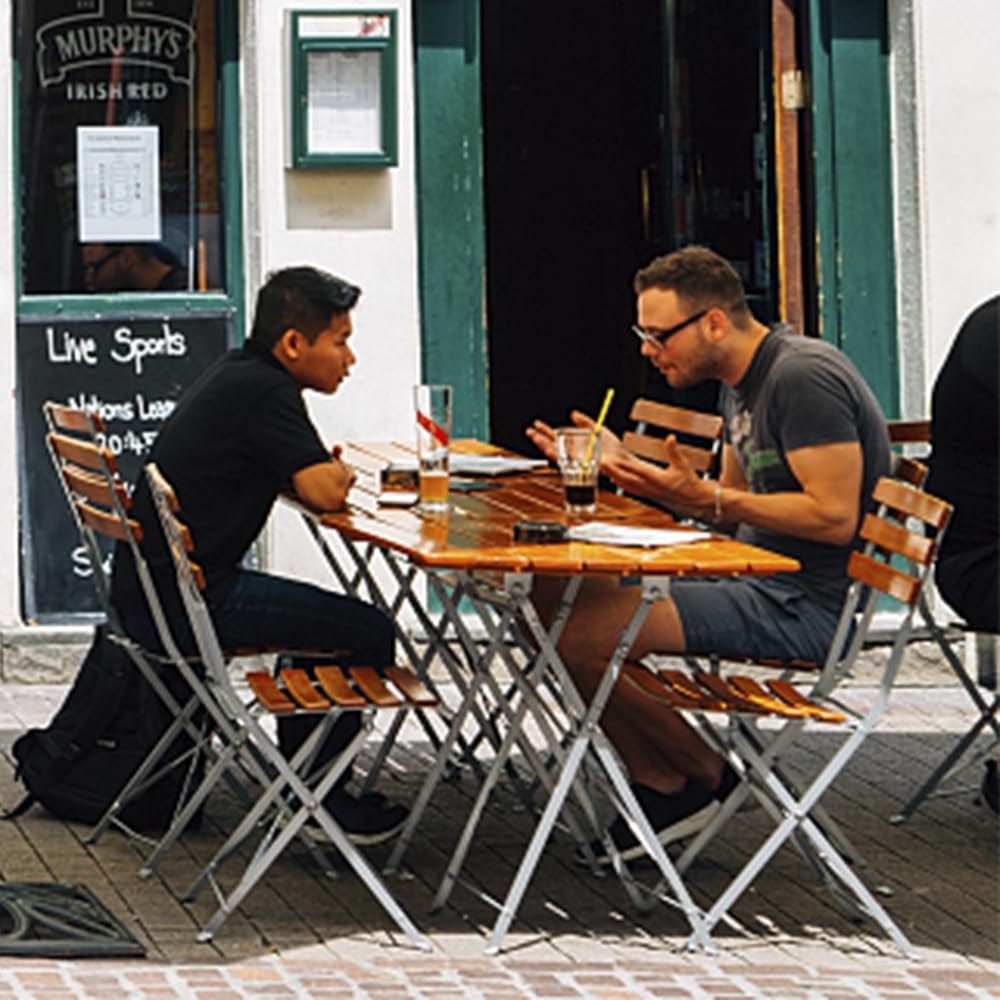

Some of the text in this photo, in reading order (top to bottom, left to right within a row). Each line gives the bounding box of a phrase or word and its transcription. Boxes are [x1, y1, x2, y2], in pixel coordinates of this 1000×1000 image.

[67, 81, 168, 100] IRISH RED
[47, 324, 187, 374] Live Sports
